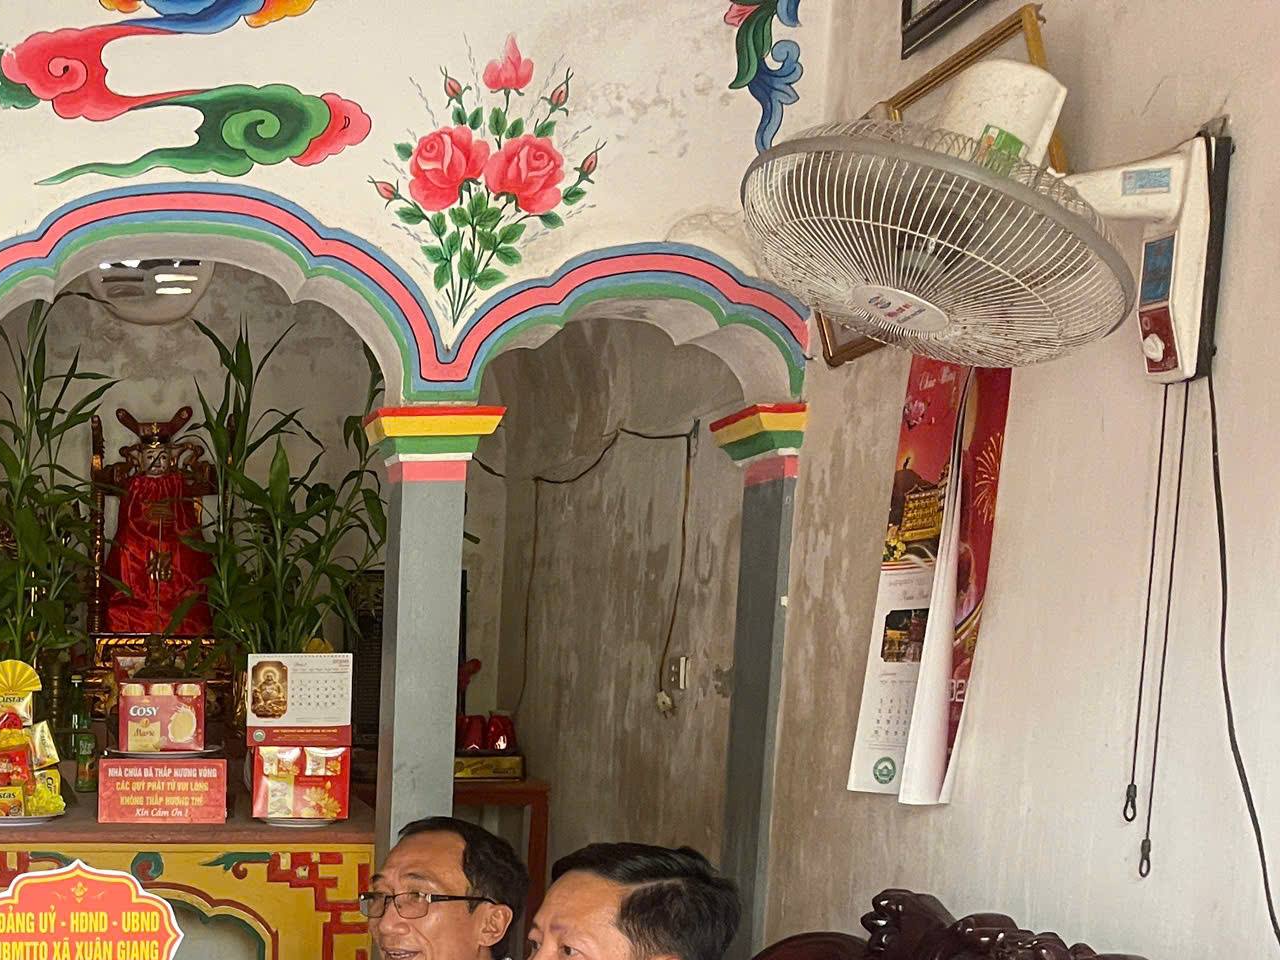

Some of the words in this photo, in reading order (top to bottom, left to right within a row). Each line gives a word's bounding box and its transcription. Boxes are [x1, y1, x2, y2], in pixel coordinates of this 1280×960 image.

[129, 705, 160, 717] COSY
[71, 911, 108, 933] HĐND
[122, 911, 160, 933] UBND
[52, 937, 70, 960] XÃ
[75, 938, 112, 960] XUÂN
[117, 940, 159, 960] GIANG
